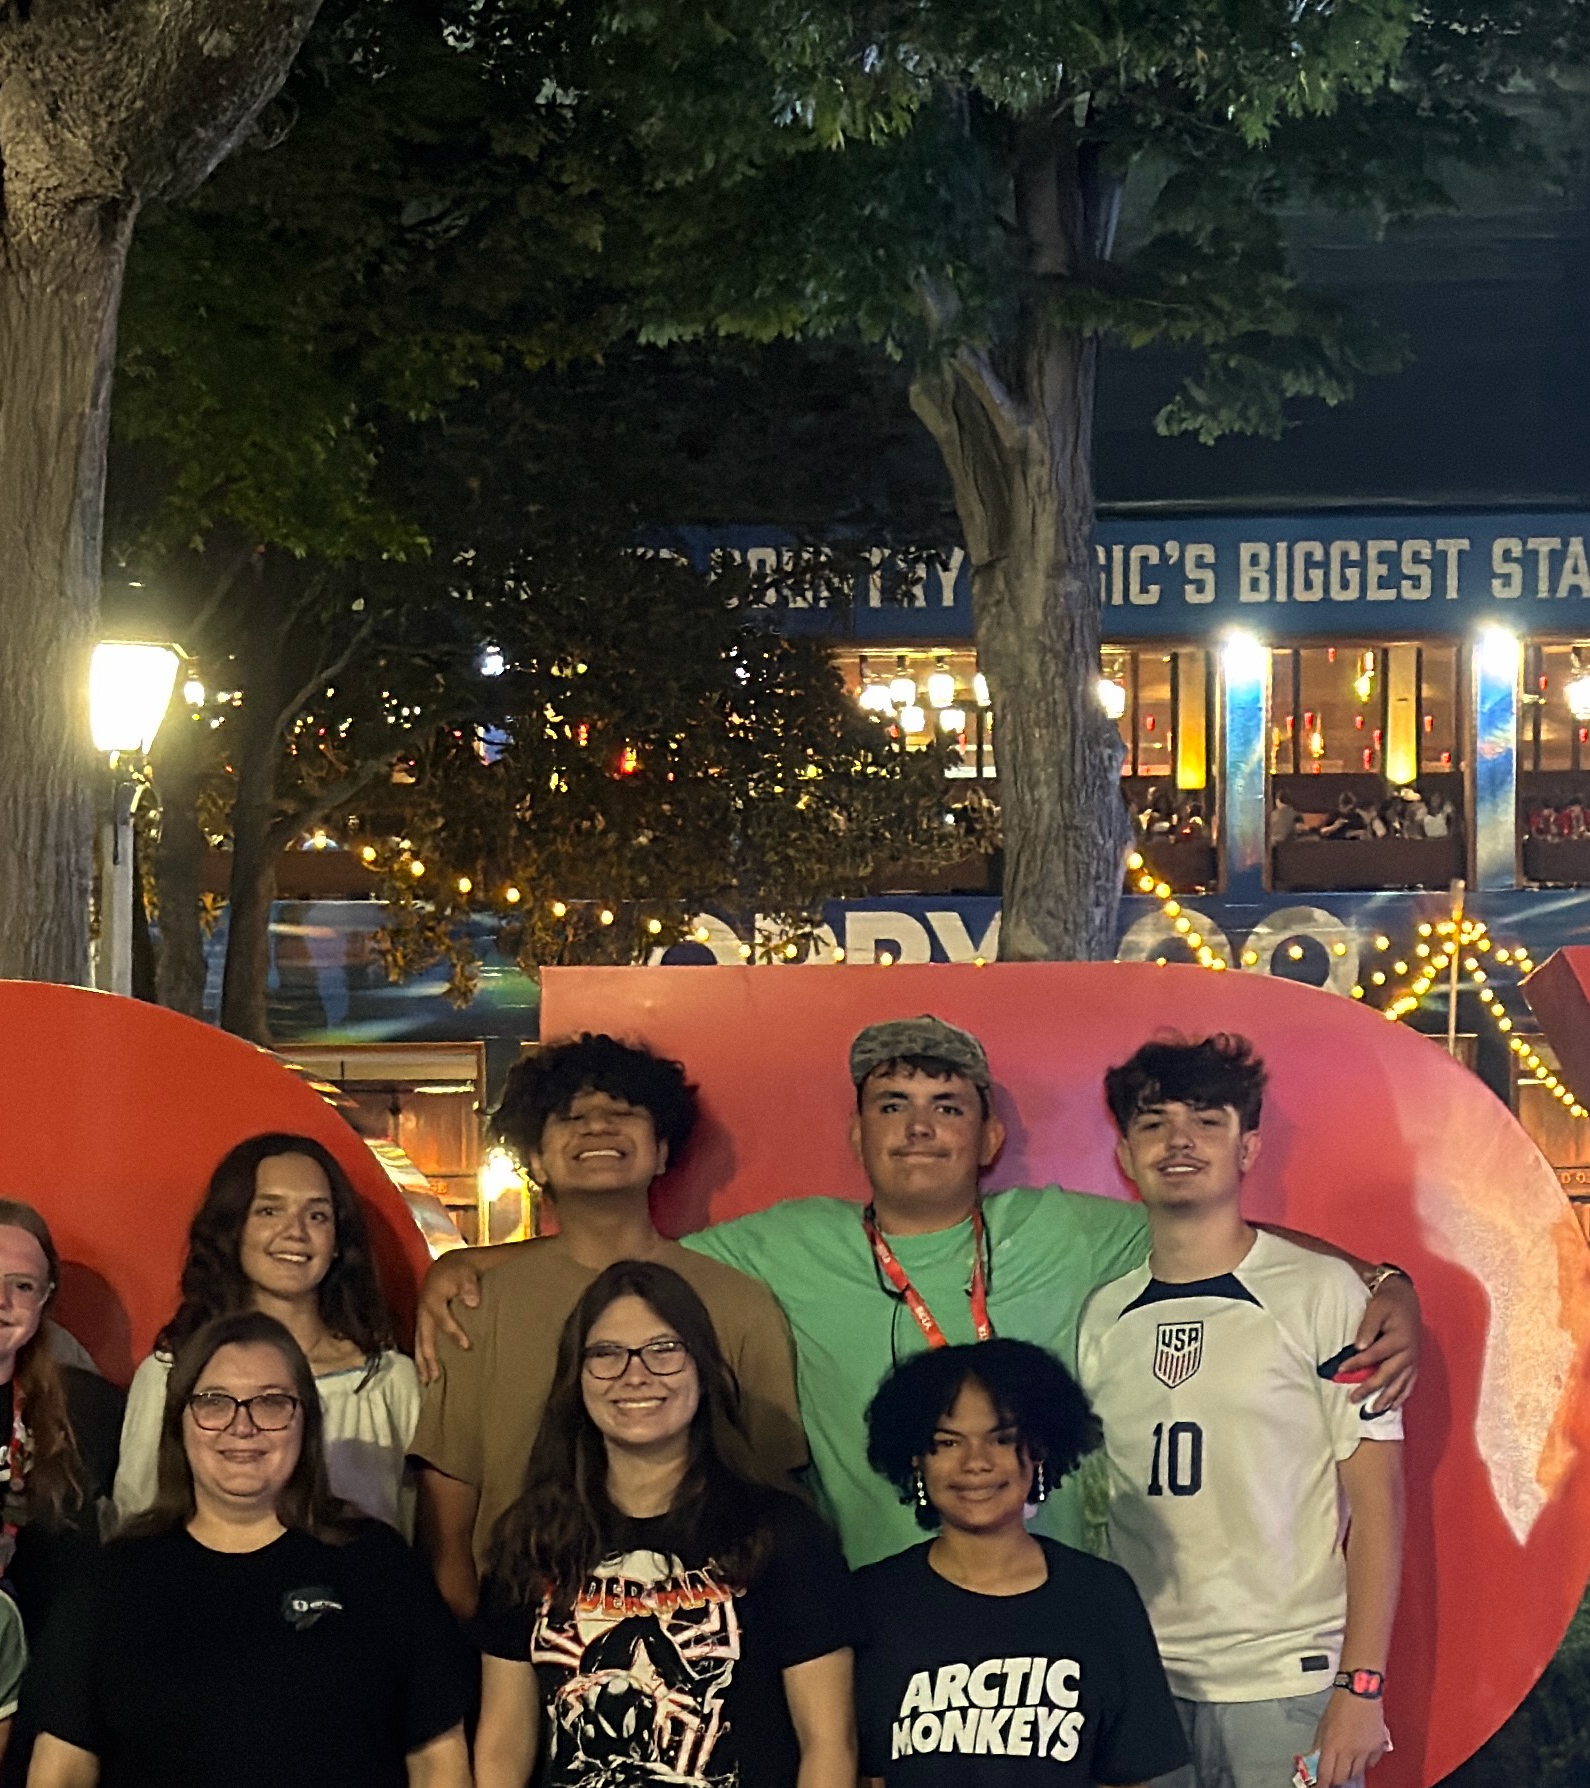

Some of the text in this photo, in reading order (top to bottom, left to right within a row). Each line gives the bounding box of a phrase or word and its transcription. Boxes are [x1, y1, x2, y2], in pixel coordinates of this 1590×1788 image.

[1096, 541, 1216, 606] IC'S
[1239, 538, 1470, 602] BIGGEST
[1161, 1327, 1199, 1353] USA
[1147, 1420, 1203, 1496] 10
[899, 1657, 1081, 1718] ARCTIC
[891, 1706, 1086, 1762] MONKEYS
